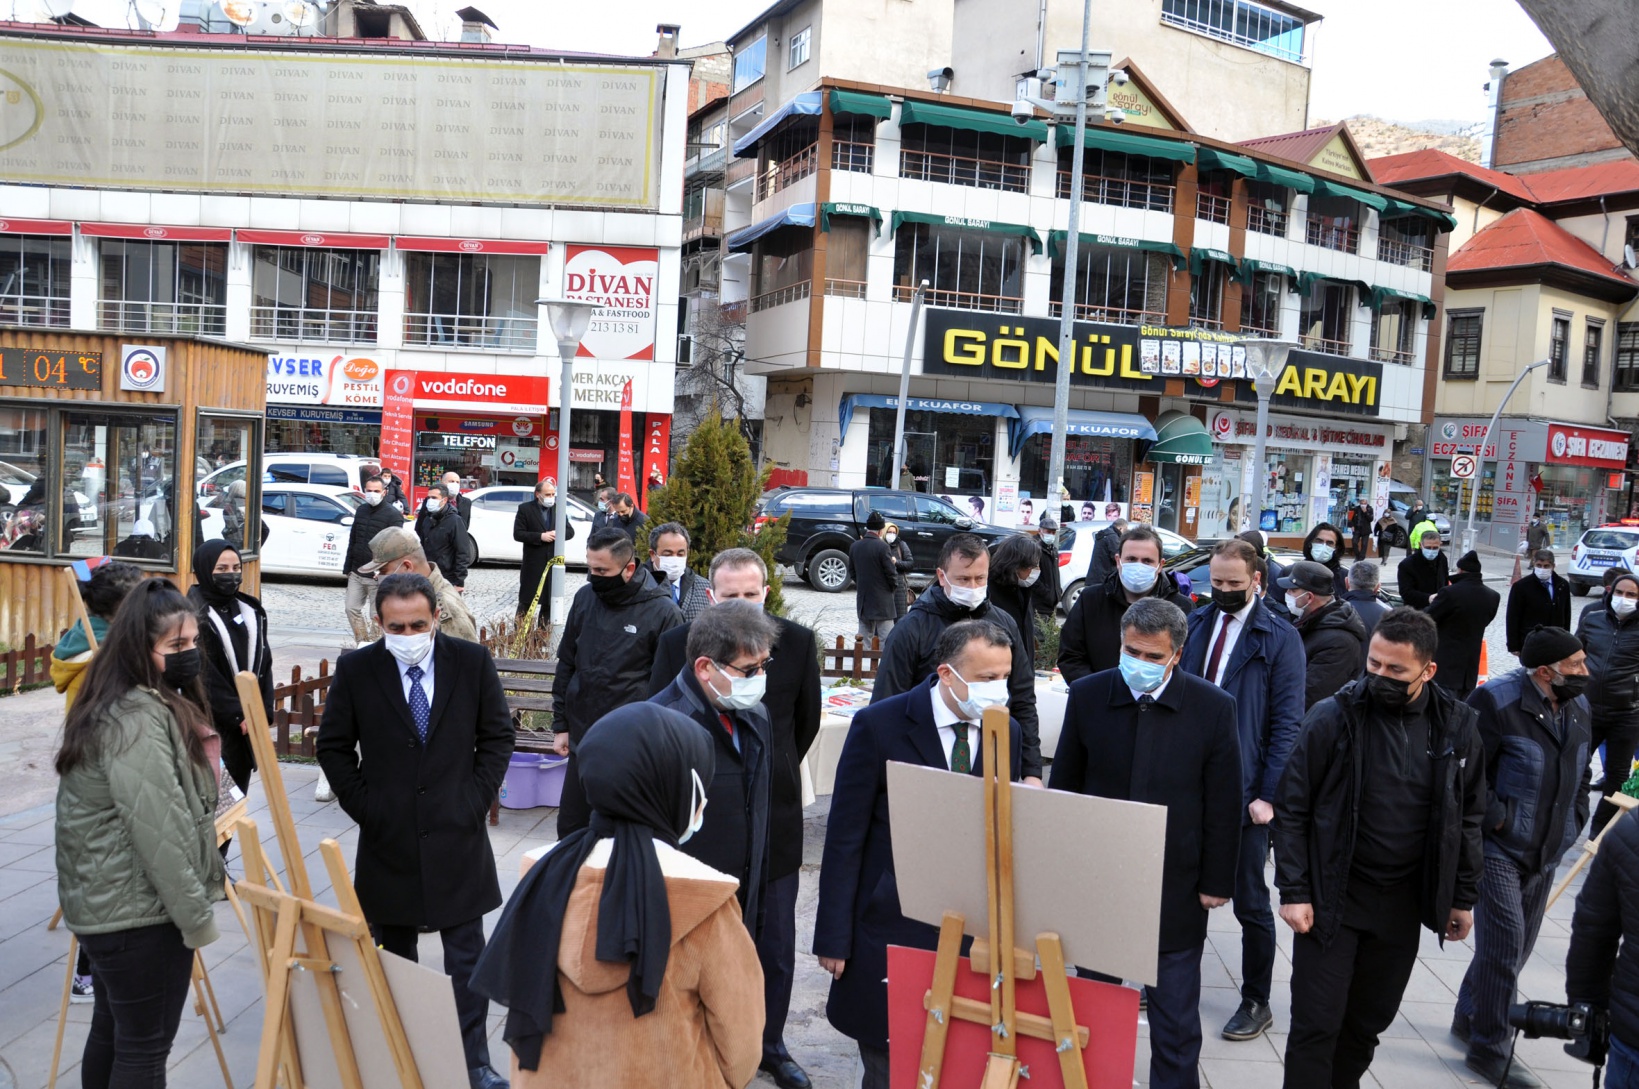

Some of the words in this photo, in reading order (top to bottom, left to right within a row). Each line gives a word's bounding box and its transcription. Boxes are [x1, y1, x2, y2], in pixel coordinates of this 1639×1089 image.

[967, 217, 990, 228] SARAYI
[1118, 237, 1139, 247] SARAYI
[566, 268, 654, 296] DİVAN
[598, 309, 604, 317] &
[606, 310, 650, 319] FASTFOOD
[591, 321, 610, 332] 213
[612, 322, 625, 333] 13
[627, 323, 639, 334] 81
[34, 355, 68, 384] 04
[267, 357, 323, 376] VSER
[345, 361, 377, 377] Doğa
[943, 325, 1153, 380] GÖNÜL
[1251, 365, 1377, 406] ARAYI
[561, 373, 593, 384] MER
[422, 378, 507, 397] vodafone
[345, 393, 378, 404] KÖME
[386, 394, 413, 404] vodafone
[574, 388, 625, 404] MERKE
[886, 398, 914, 406] ELT
[267, 408, 297, 417] KEVSER
[300, 410, 344, 422] KURUYEMİŞ
[463, 420, 494, 428] SAMSUNG
[1236, 417, 1273, 439] ŞİFAD
[1462, 422, 1488, 441] ŞİFA
[442, 434, 496, 448] TELEFON
[1566, 431, 1586, 458] ŞİFA
[1433, 442, 1496, 457] ECZESİ
[1505, 432, 1518, 491] ECZANE
[1497, 495, 1518, 506] ŞİFA
